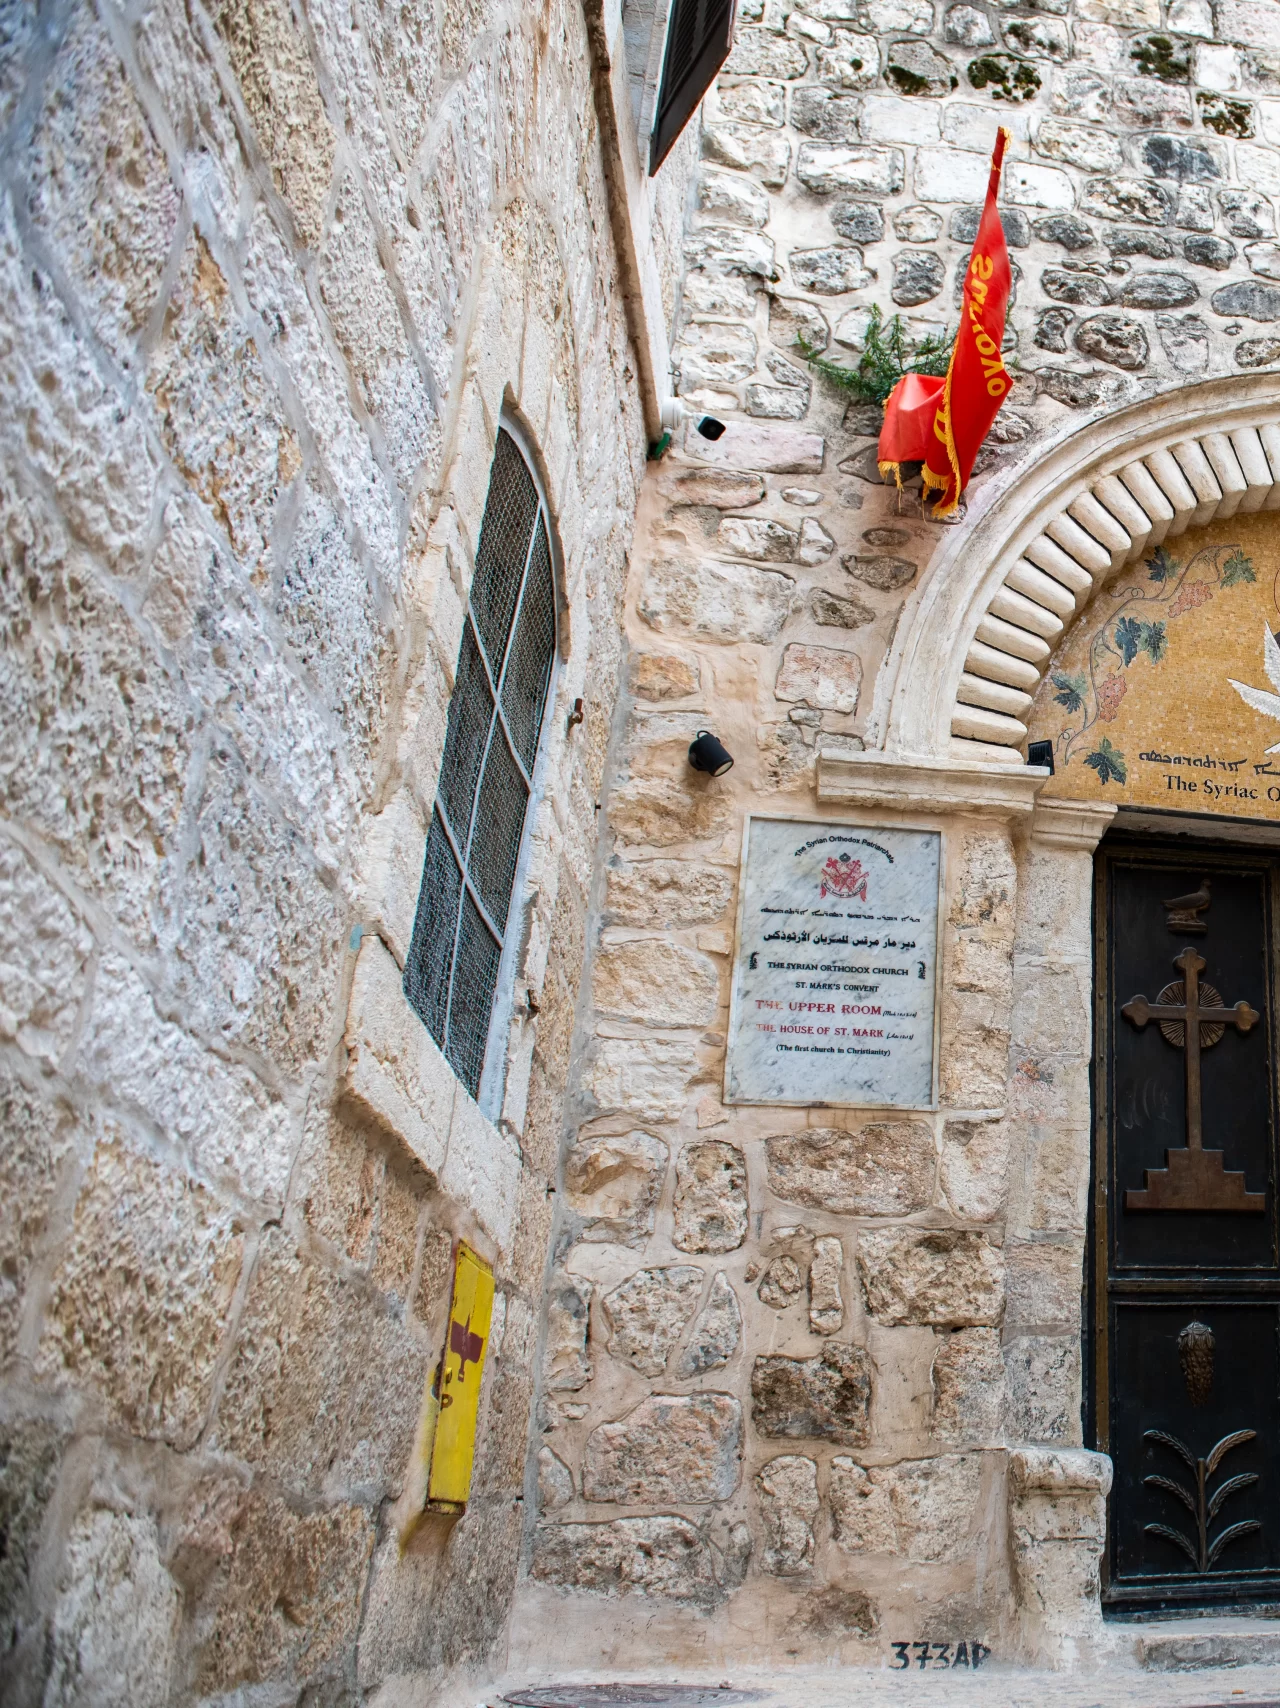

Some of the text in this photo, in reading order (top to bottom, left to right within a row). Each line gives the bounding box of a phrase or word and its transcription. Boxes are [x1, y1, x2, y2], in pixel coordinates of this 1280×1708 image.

[1162, 774, 1198, 792] The
[1203, 778, 1259, 800] Syriac
[795, 845, 807, 858] The
[806, 838, 828, 848] Syrian
[829, 835, 860, 844] Orthodox
[813, 933, 849, 946] للسريان
[852, 934, 880, 948] مرقس
[882, 937, 897, 949] مار
[900, 940, 916, 951] دير
[767, 961, 909, 976] THE SYRIAN ORTHODOX CHURCH
[795, 981, 879, 993] ST. MARK'S CONVENT
[755, 1000, 784, 1010] THE
[788, 1002, 836, 1013] UPPER
[841, 1004, 882, 1016] ROOM
[756, 1023, 777, 1033] THE
[779, 1025, 814, 1035] HOUSE
[816, 1026, 831, 1035] OF
[834, 1027, 850, 1036] ST.
[852, 1028, 884, 1038] MARK
[775, 1044, 891, 1057] (The first church in Christianity)
